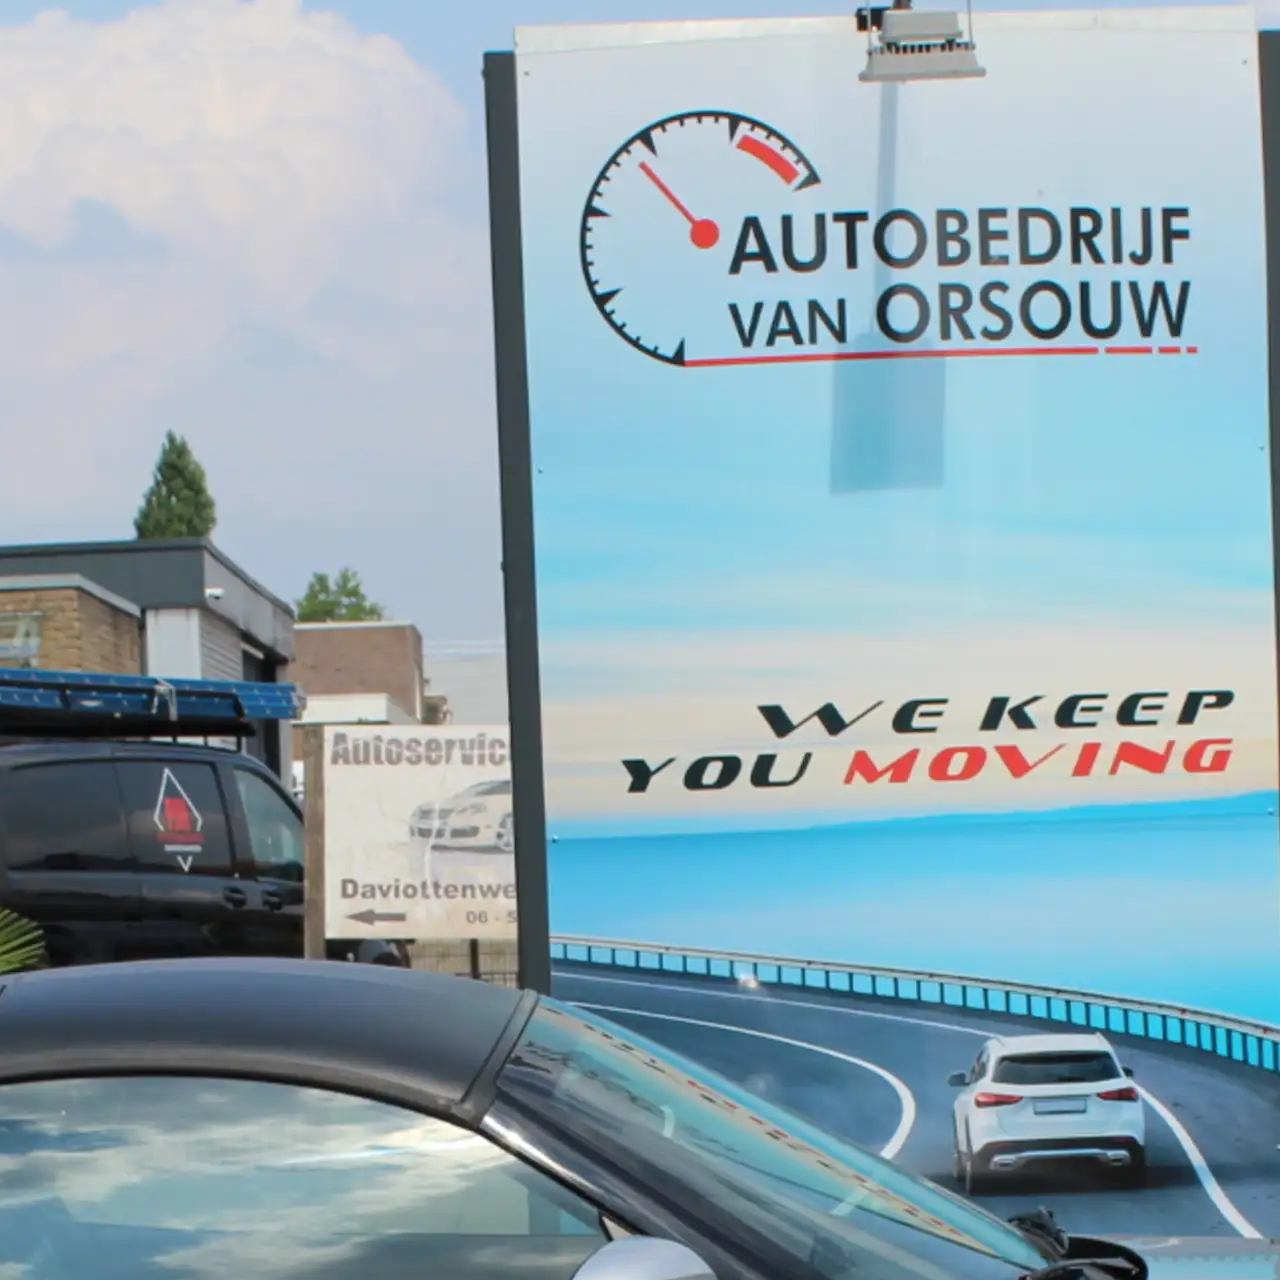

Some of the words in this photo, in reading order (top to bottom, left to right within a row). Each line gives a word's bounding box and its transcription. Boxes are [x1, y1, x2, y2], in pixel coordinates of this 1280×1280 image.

[727, 206, 1191, 275] AUTOBEDRIJF
[727, 298, 848, 348] VAN
[875, 280, 1192, 344] ORSOUW
[756, 697, 950, 739] WE
[978, 690, 1235, 732] KEEP
[620, 752, 813, 794] YOU
[843, 738, 1234, 786] MOVING
